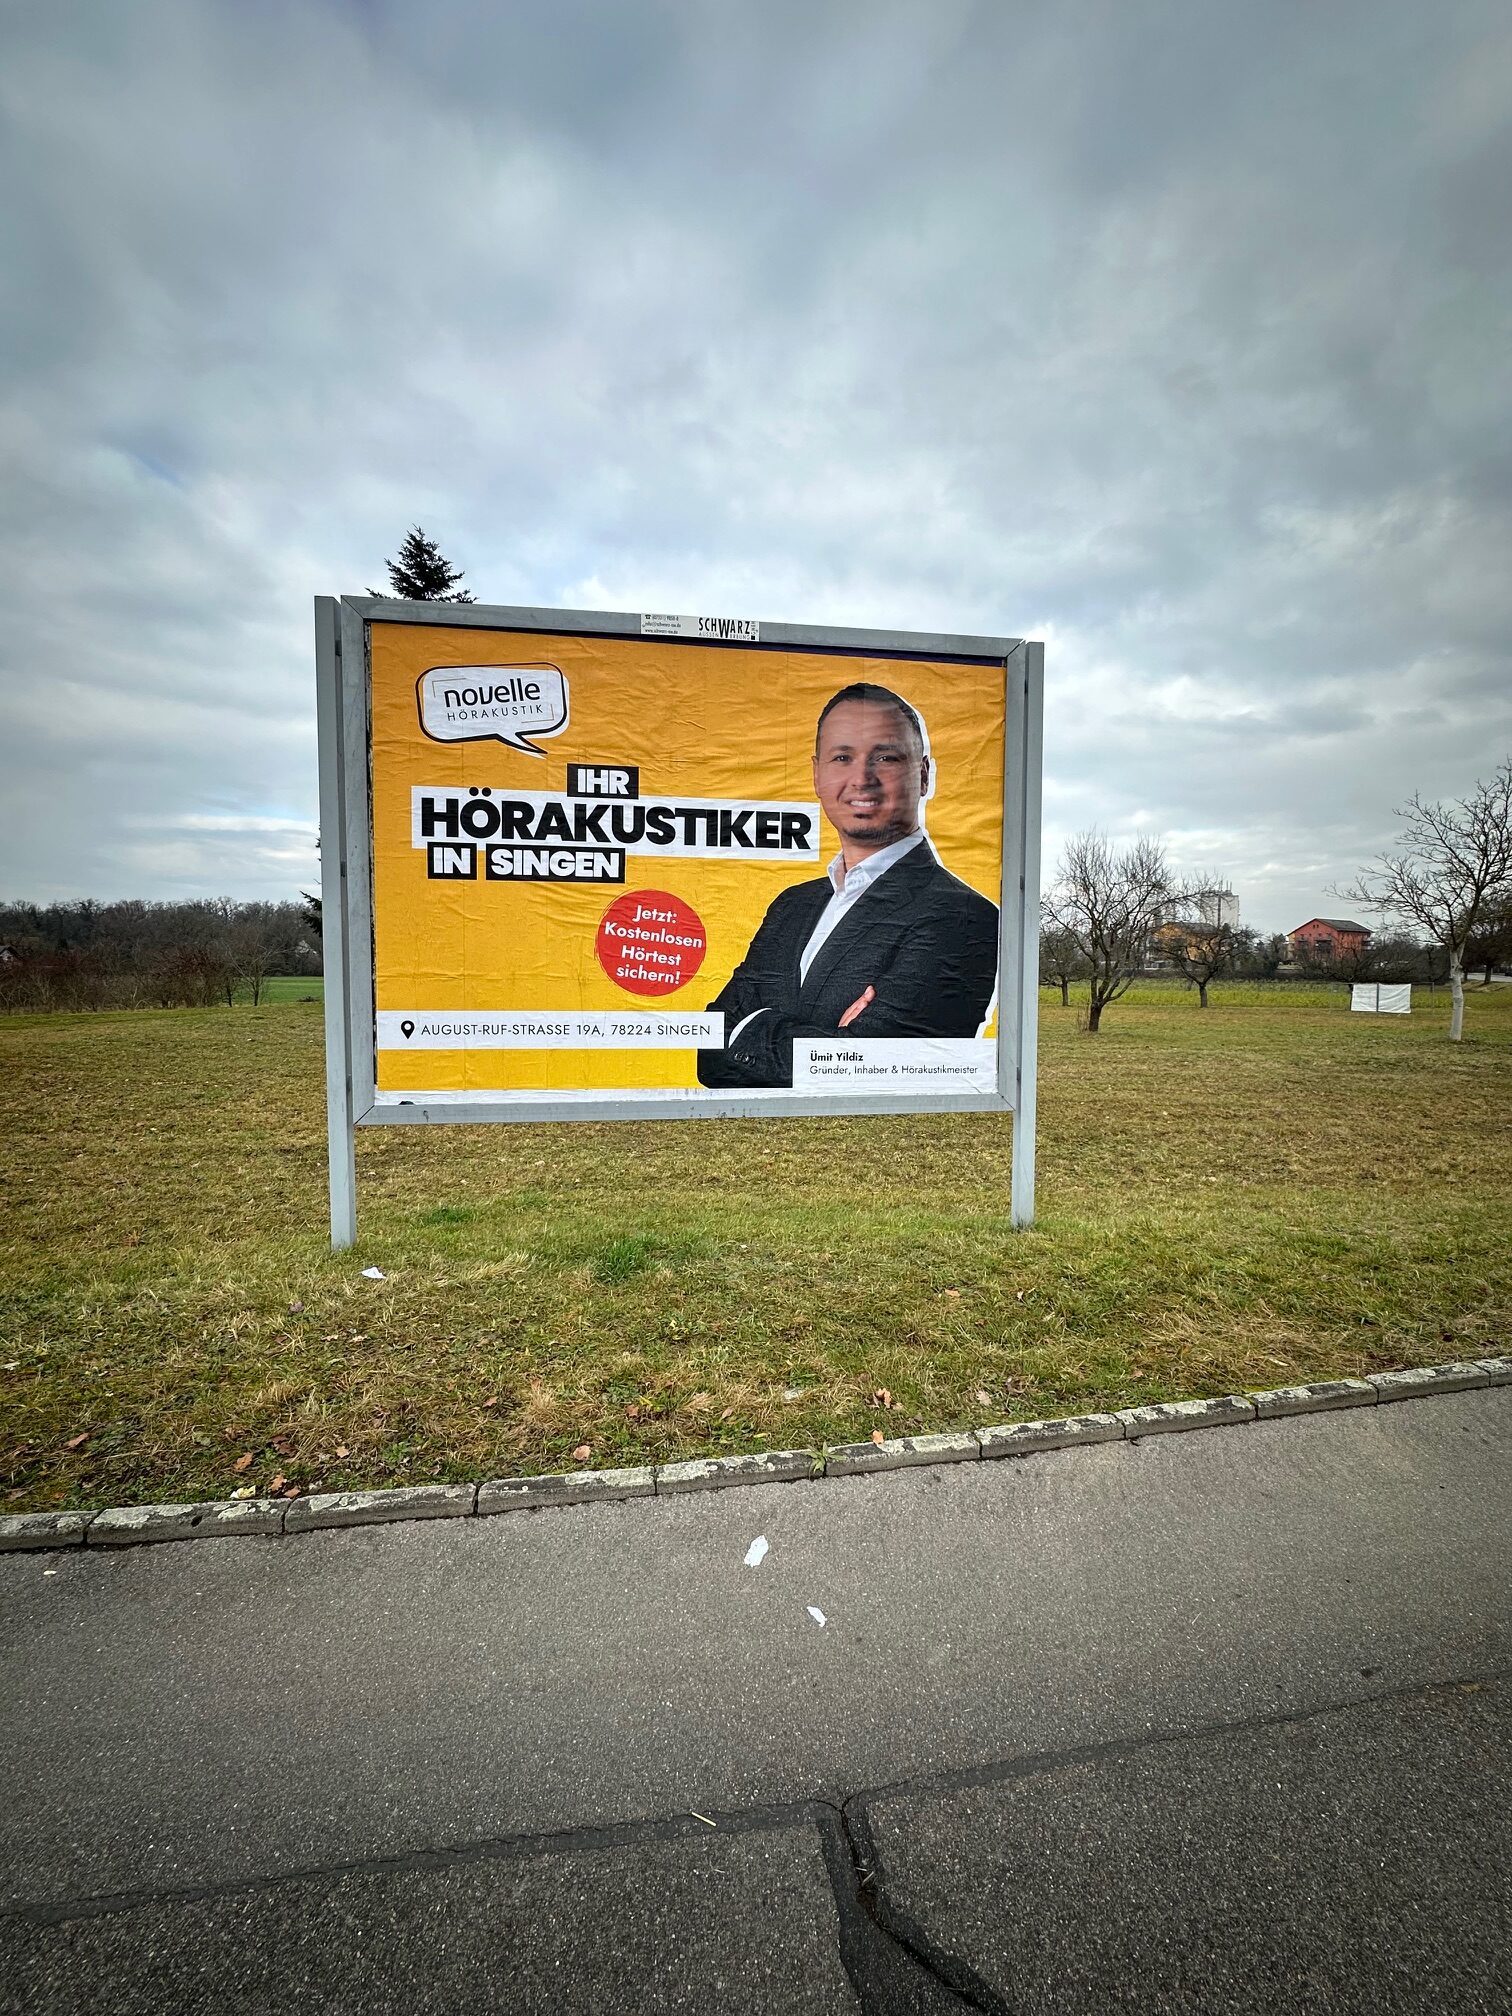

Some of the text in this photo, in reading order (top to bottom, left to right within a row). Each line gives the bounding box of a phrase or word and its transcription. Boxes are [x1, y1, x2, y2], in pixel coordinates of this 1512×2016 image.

[699, 617, 750, 638] SCHWARZ
[444, 678, 540, 708] novelle
[447, 704, 543, 721] HÖRAKUSTIK
[577, 768, 630, 795] IHR
[421, 786, 812, 850] HÖRAKUSTIKER
[433, 847, 620, 878] IN SINGEN
[632, 905, 677, 924] Jetzt:
[604, 921, 703, 948] Kostenlosen
[621, 945, 681, 966] Hörtest
[616, 963, 681, 985] sichern!
[421, 1024, 711, 1037] AUGUST-RUF-STRASSE 19A, 78224 SINGEN
[810, 1050, 864, 1062] Ümit Yildiz
[809, 1064, 978, 1075] Gründer, Inhaber & Hörakustikmeister
